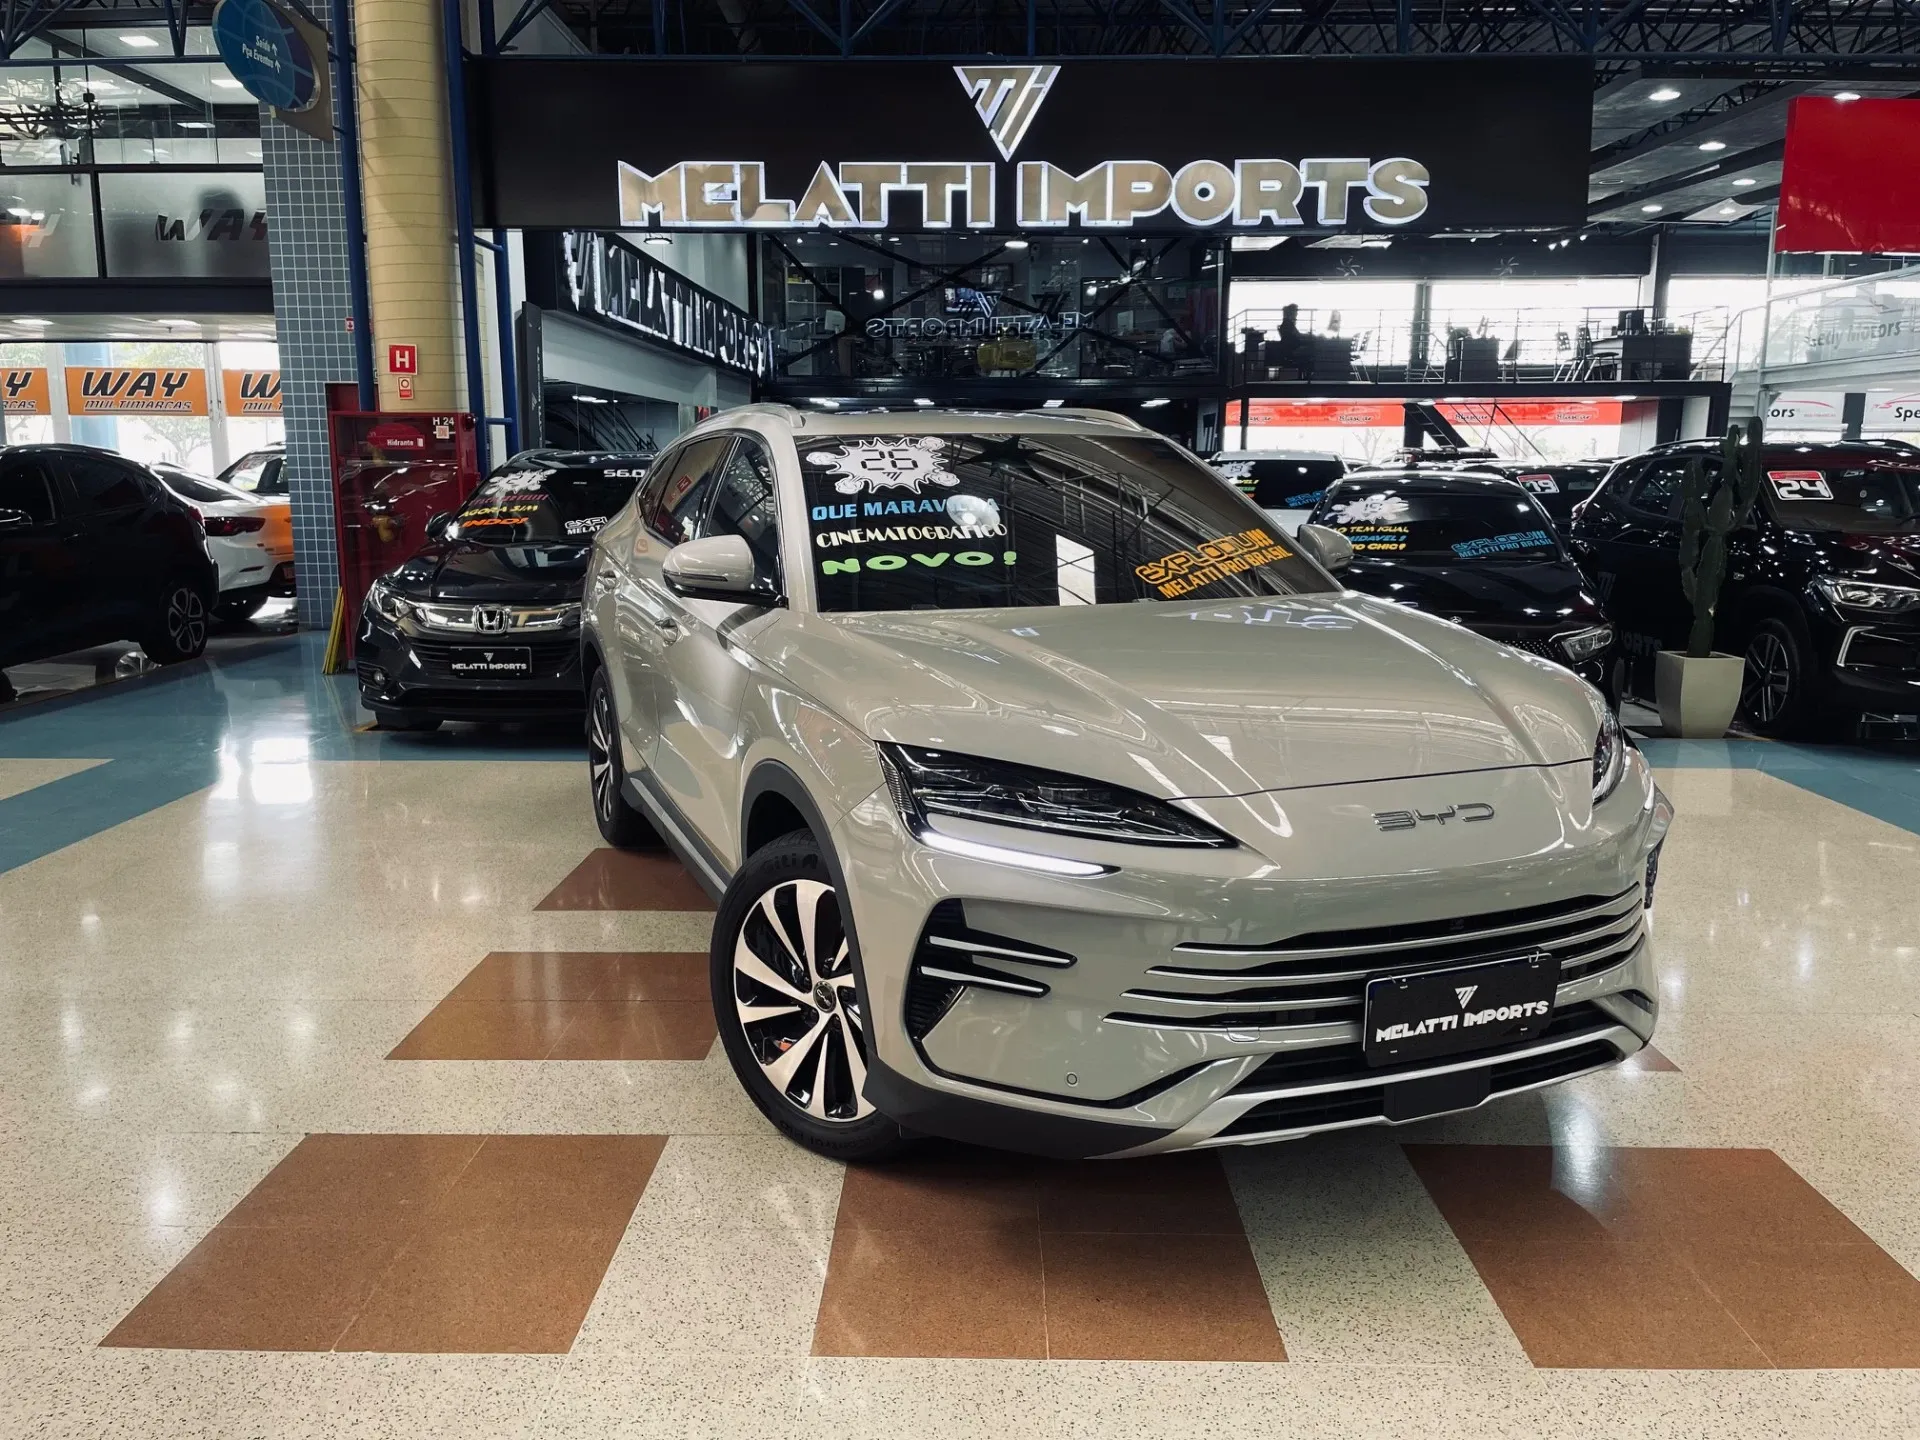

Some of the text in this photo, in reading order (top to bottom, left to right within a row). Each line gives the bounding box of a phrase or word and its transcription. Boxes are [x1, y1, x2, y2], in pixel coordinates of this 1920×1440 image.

[617, 156, 1430, 228] MELATTI IMPORTS
[395, 350, 410, 368] H
[81, 370, 190, 398] WAY
[240, 372, 281, 399] W
[84, 400, 192, 410] MULTIMARCAS
[1767, 406, 1796, 418] ors
[432, 416, 455, 426] H 24
[386, 438, 414, 446] Hidrante
[861, 448, 919, 471] 26
[1778, 479, 1830, 499] 24
[462, 504, 539, 517] AGORA SIM
[811, 503, 858, 521] QUE
[566, 525, 602, 536] MELAT
[1458, 539, 1555, 558] MELATTI PRO BRASIL
[821, 550, 1017, 575] NOVO!
[1157, 545, 1294, 599] MELATTI PRO BRASIL
[1371, 802, 1495, 832] BYD
[1375, 1000, 1549, 1043] MELATTI IMPORTS
